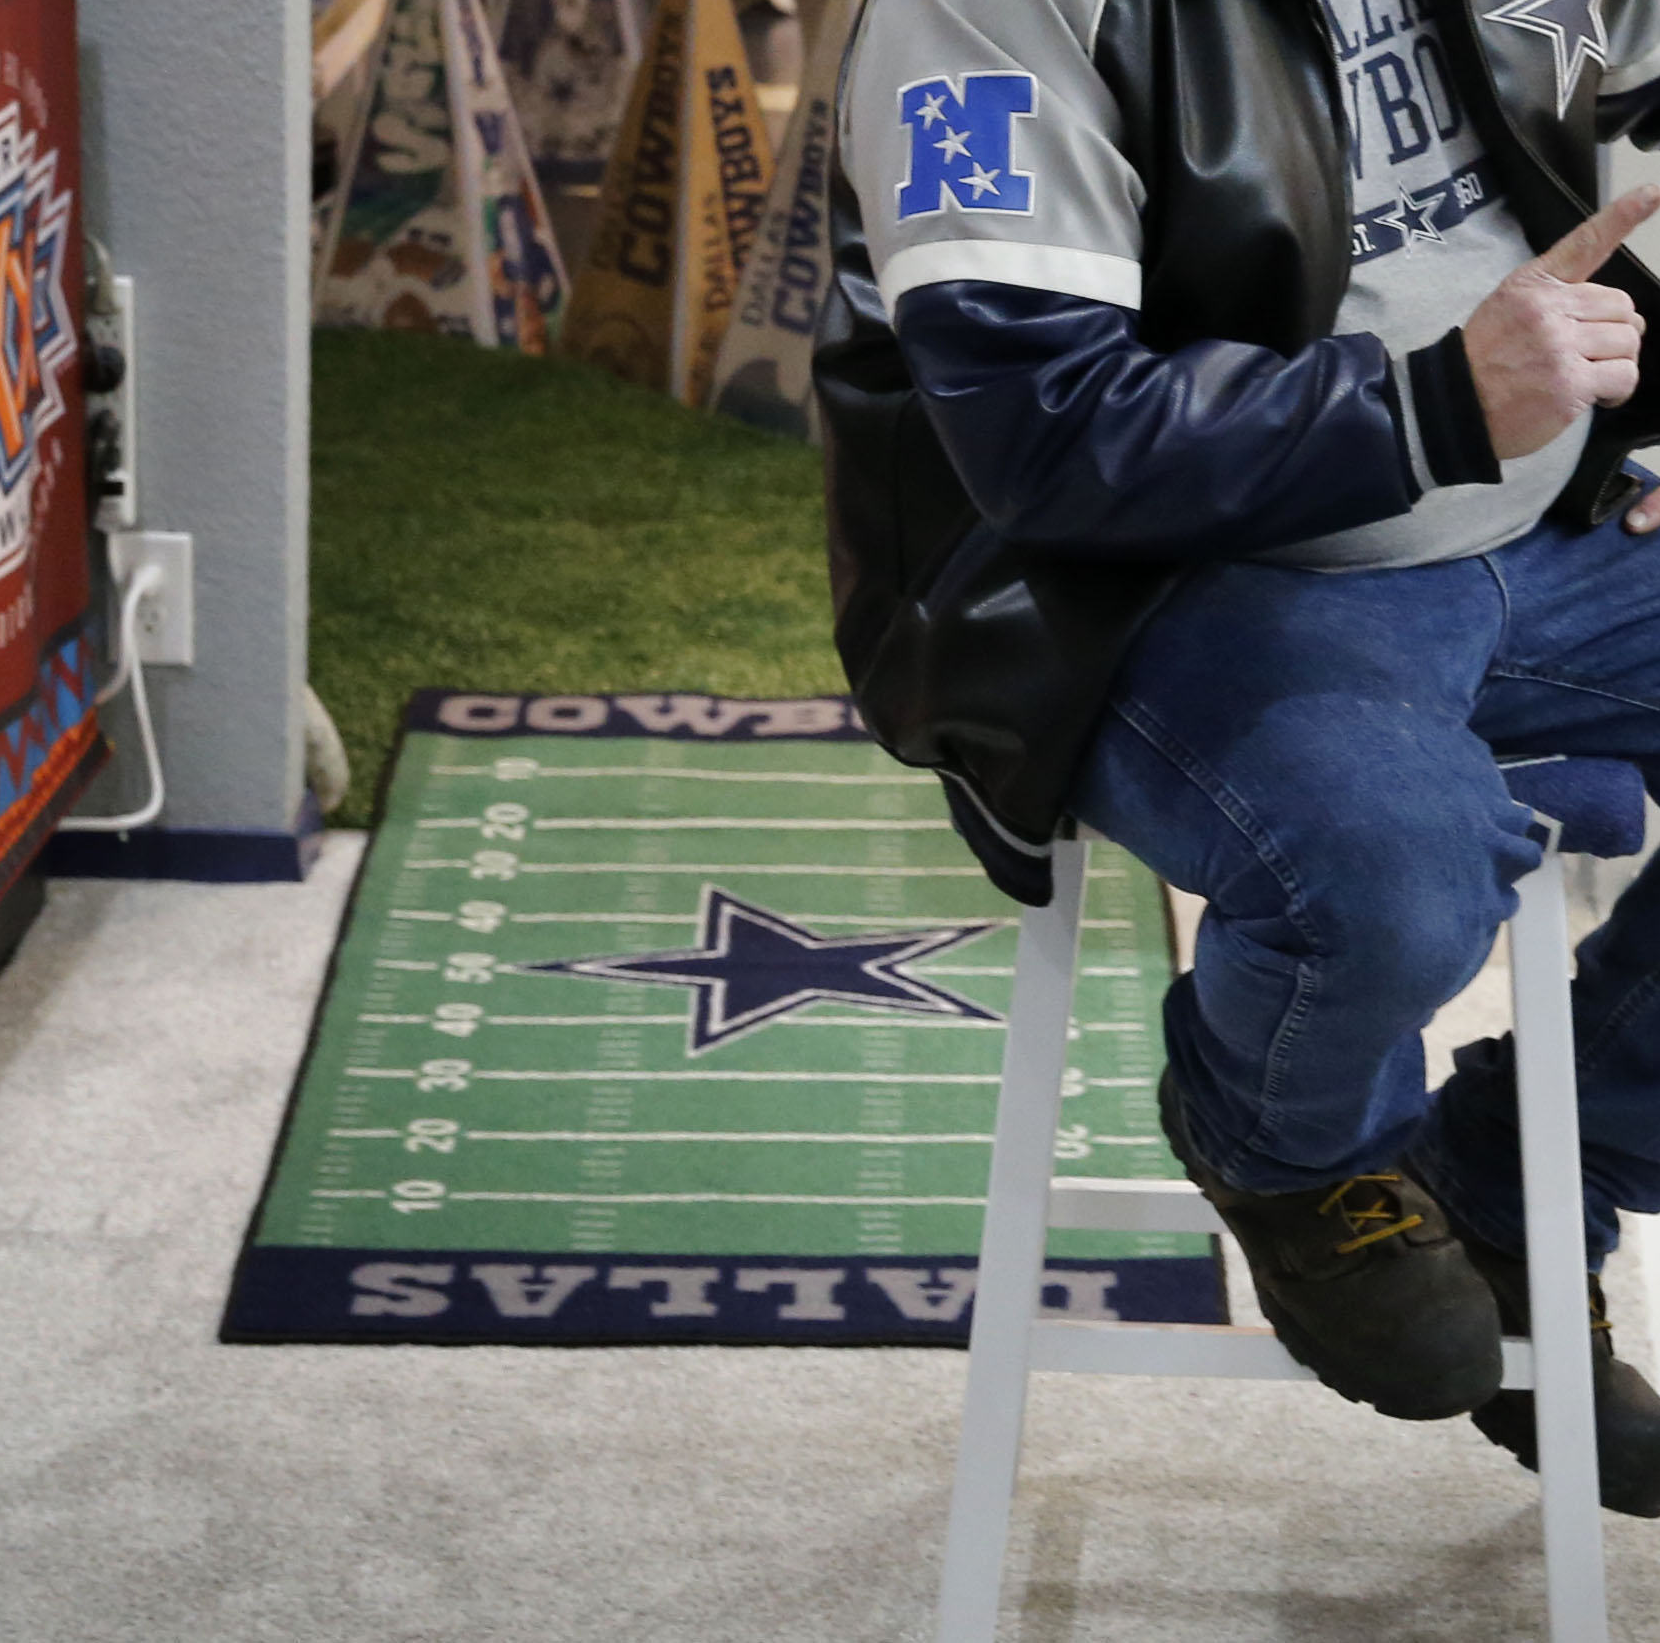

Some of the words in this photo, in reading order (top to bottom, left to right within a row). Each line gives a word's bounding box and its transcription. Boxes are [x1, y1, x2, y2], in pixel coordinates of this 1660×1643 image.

[481, 802, 530, 842] 20
[443, 952, 496, 985] 50
[431, 1002, 484, 1039] 40
[416, 1057, 473, 1094] 30
[403, 1117, 461, 1155] 20
[390, 1178, 447, 1215] 10
